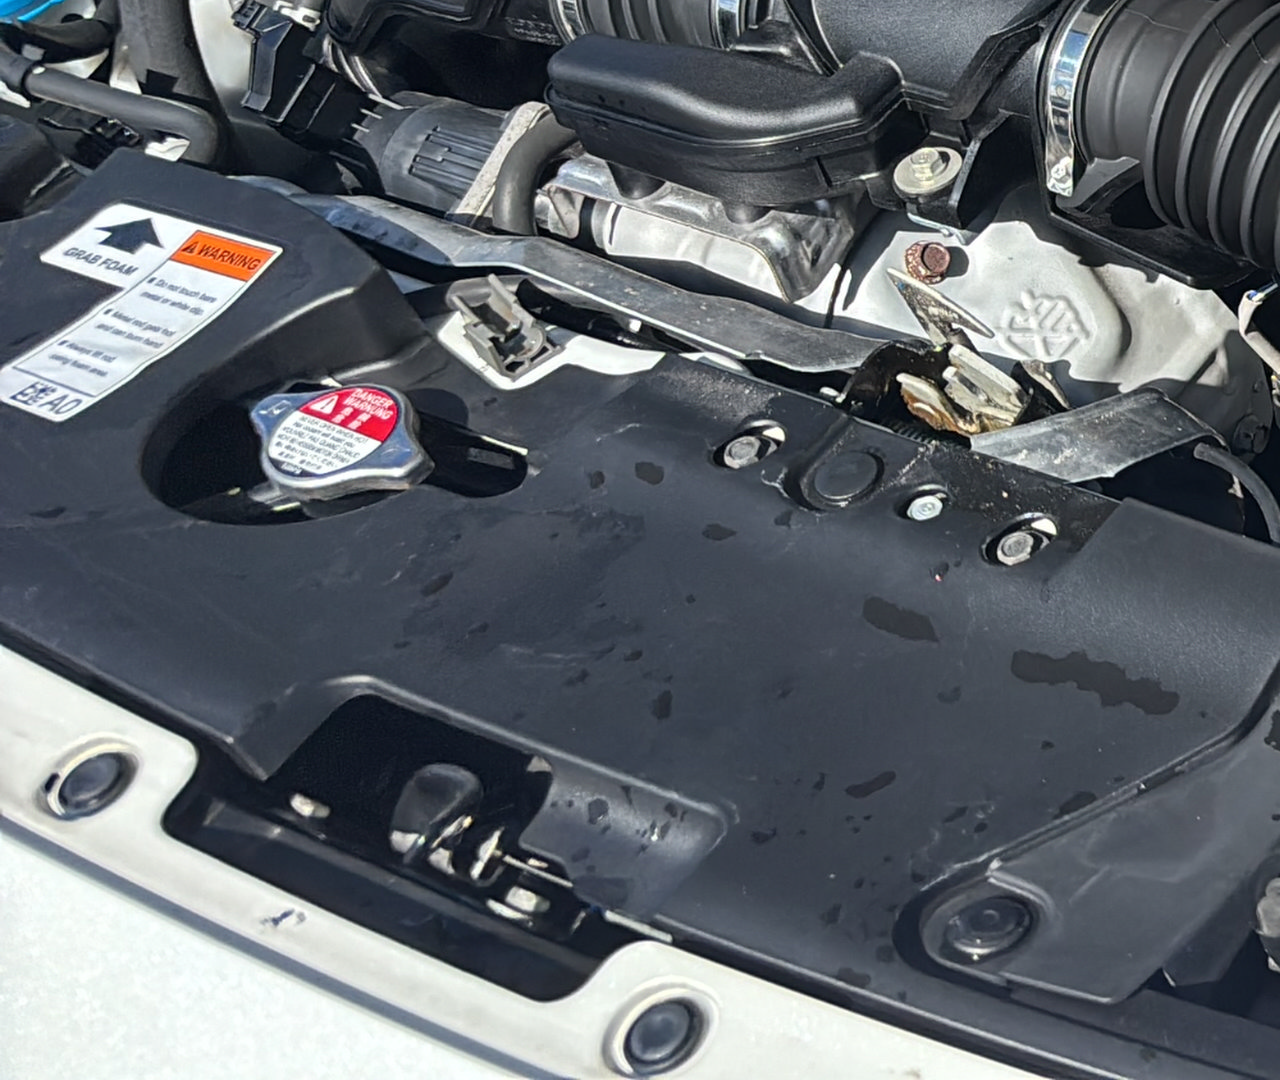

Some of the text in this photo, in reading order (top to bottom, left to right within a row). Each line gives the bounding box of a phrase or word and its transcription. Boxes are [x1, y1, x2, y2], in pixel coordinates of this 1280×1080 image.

[64, 247, 139, 276] GRAB FOAM
[198, 245, 261, 271] WARNING
[351, 387, 394, 409] DANGER
